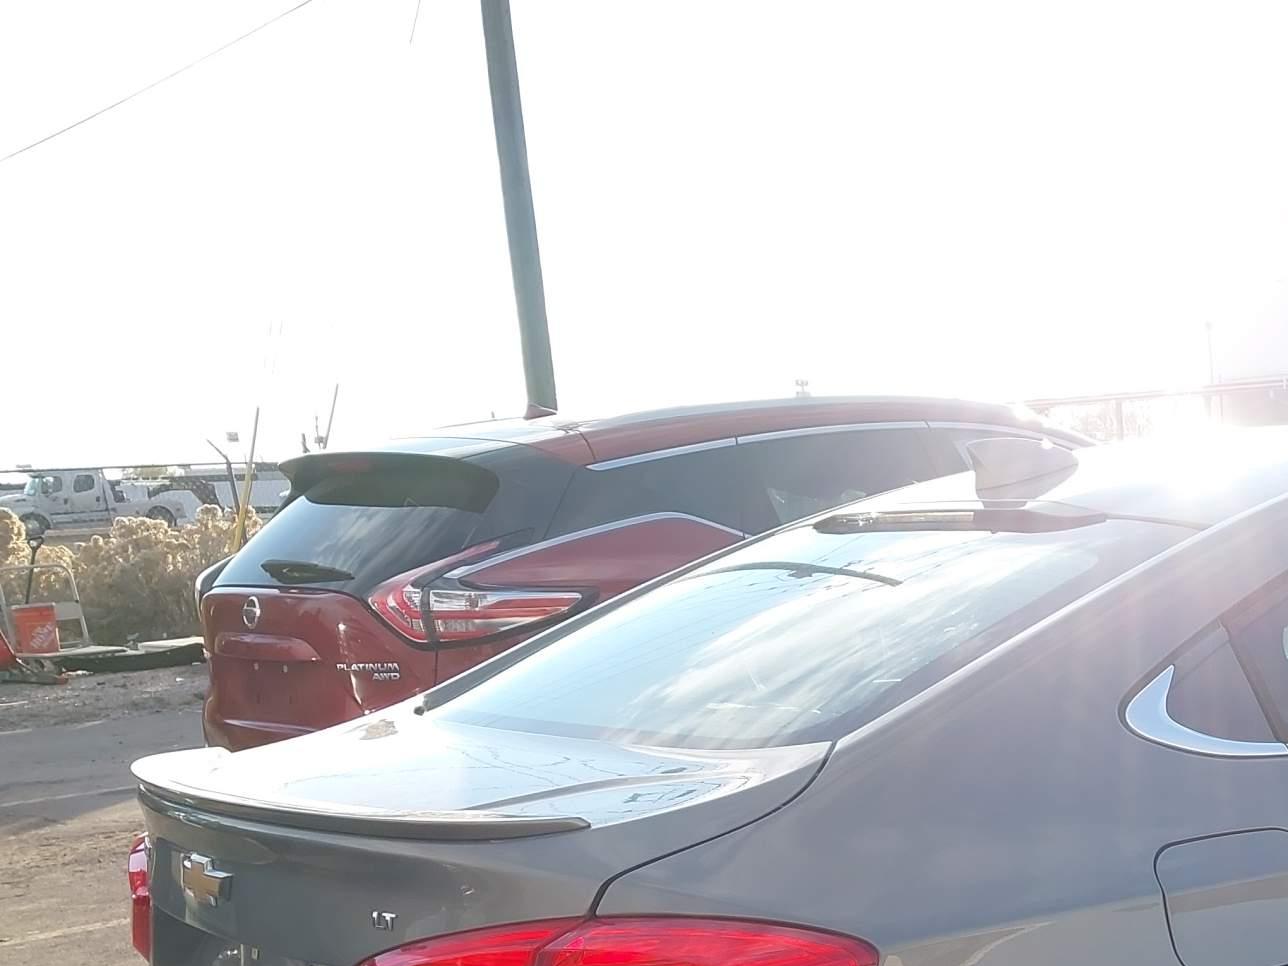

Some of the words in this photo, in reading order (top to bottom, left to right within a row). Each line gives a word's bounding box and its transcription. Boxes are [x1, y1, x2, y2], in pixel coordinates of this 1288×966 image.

[336, 662, 400, 673] PLATINUM
[372, 672, 401, 681] AWD
[372, 911, 397, 932] LT
